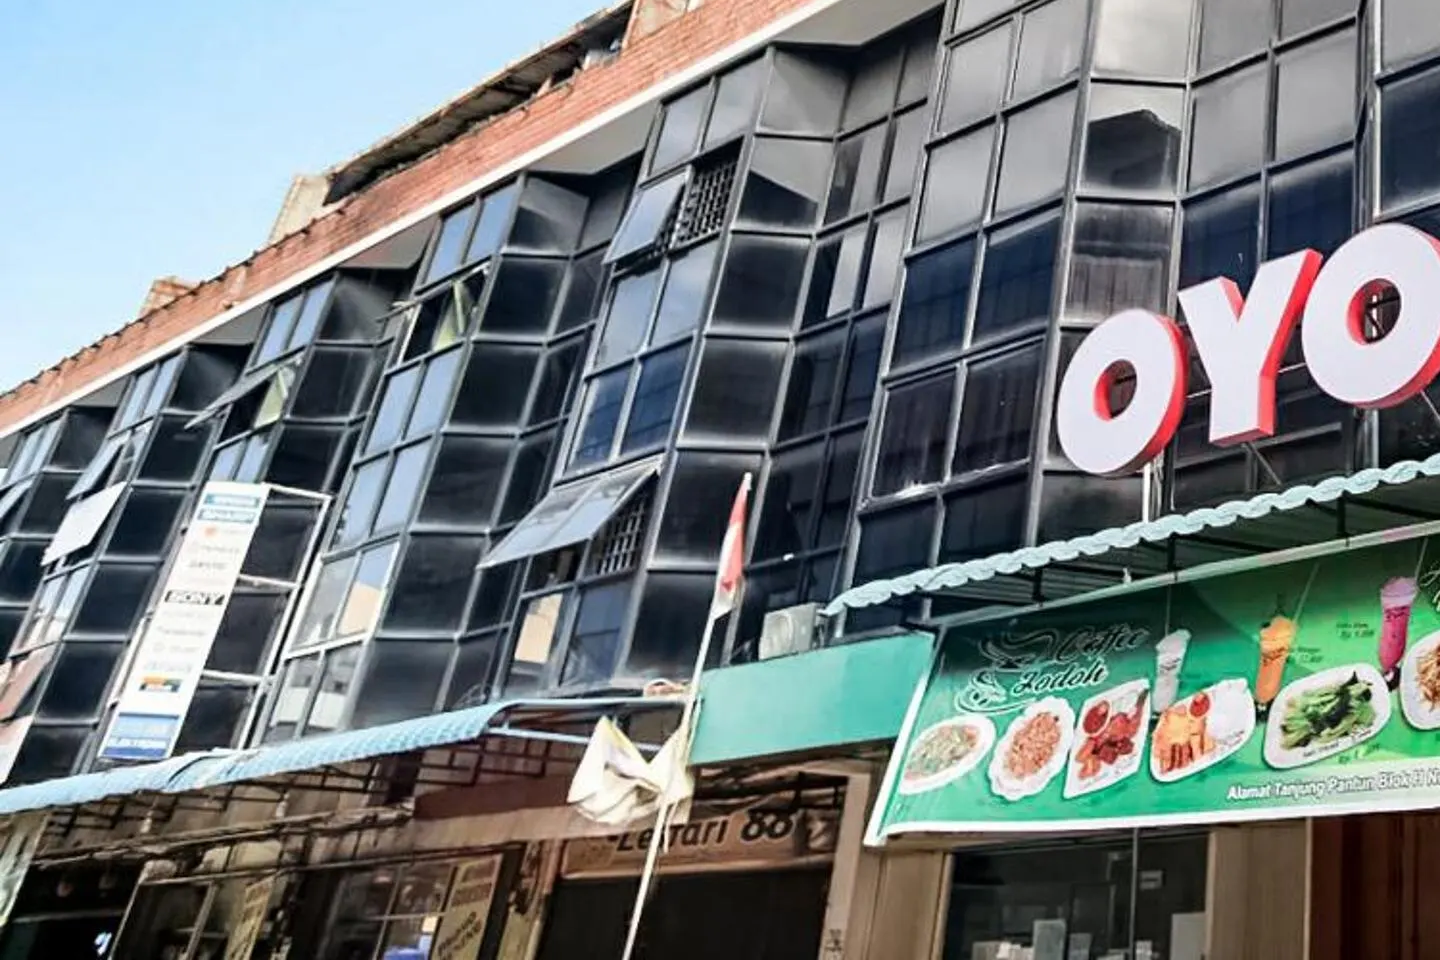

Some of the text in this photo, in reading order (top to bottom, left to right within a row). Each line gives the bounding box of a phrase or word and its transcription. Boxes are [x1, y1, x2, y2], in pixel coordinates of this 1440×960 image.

[1012, 657, 1109, 696] Jodoh
[1226, 783, 1271, 800] Alamat
[1274, 779, 1325, 801] Tanjung
[1328, 774, 1374, 793] Pantun
[1379, 770, 1411, 789] Blok
